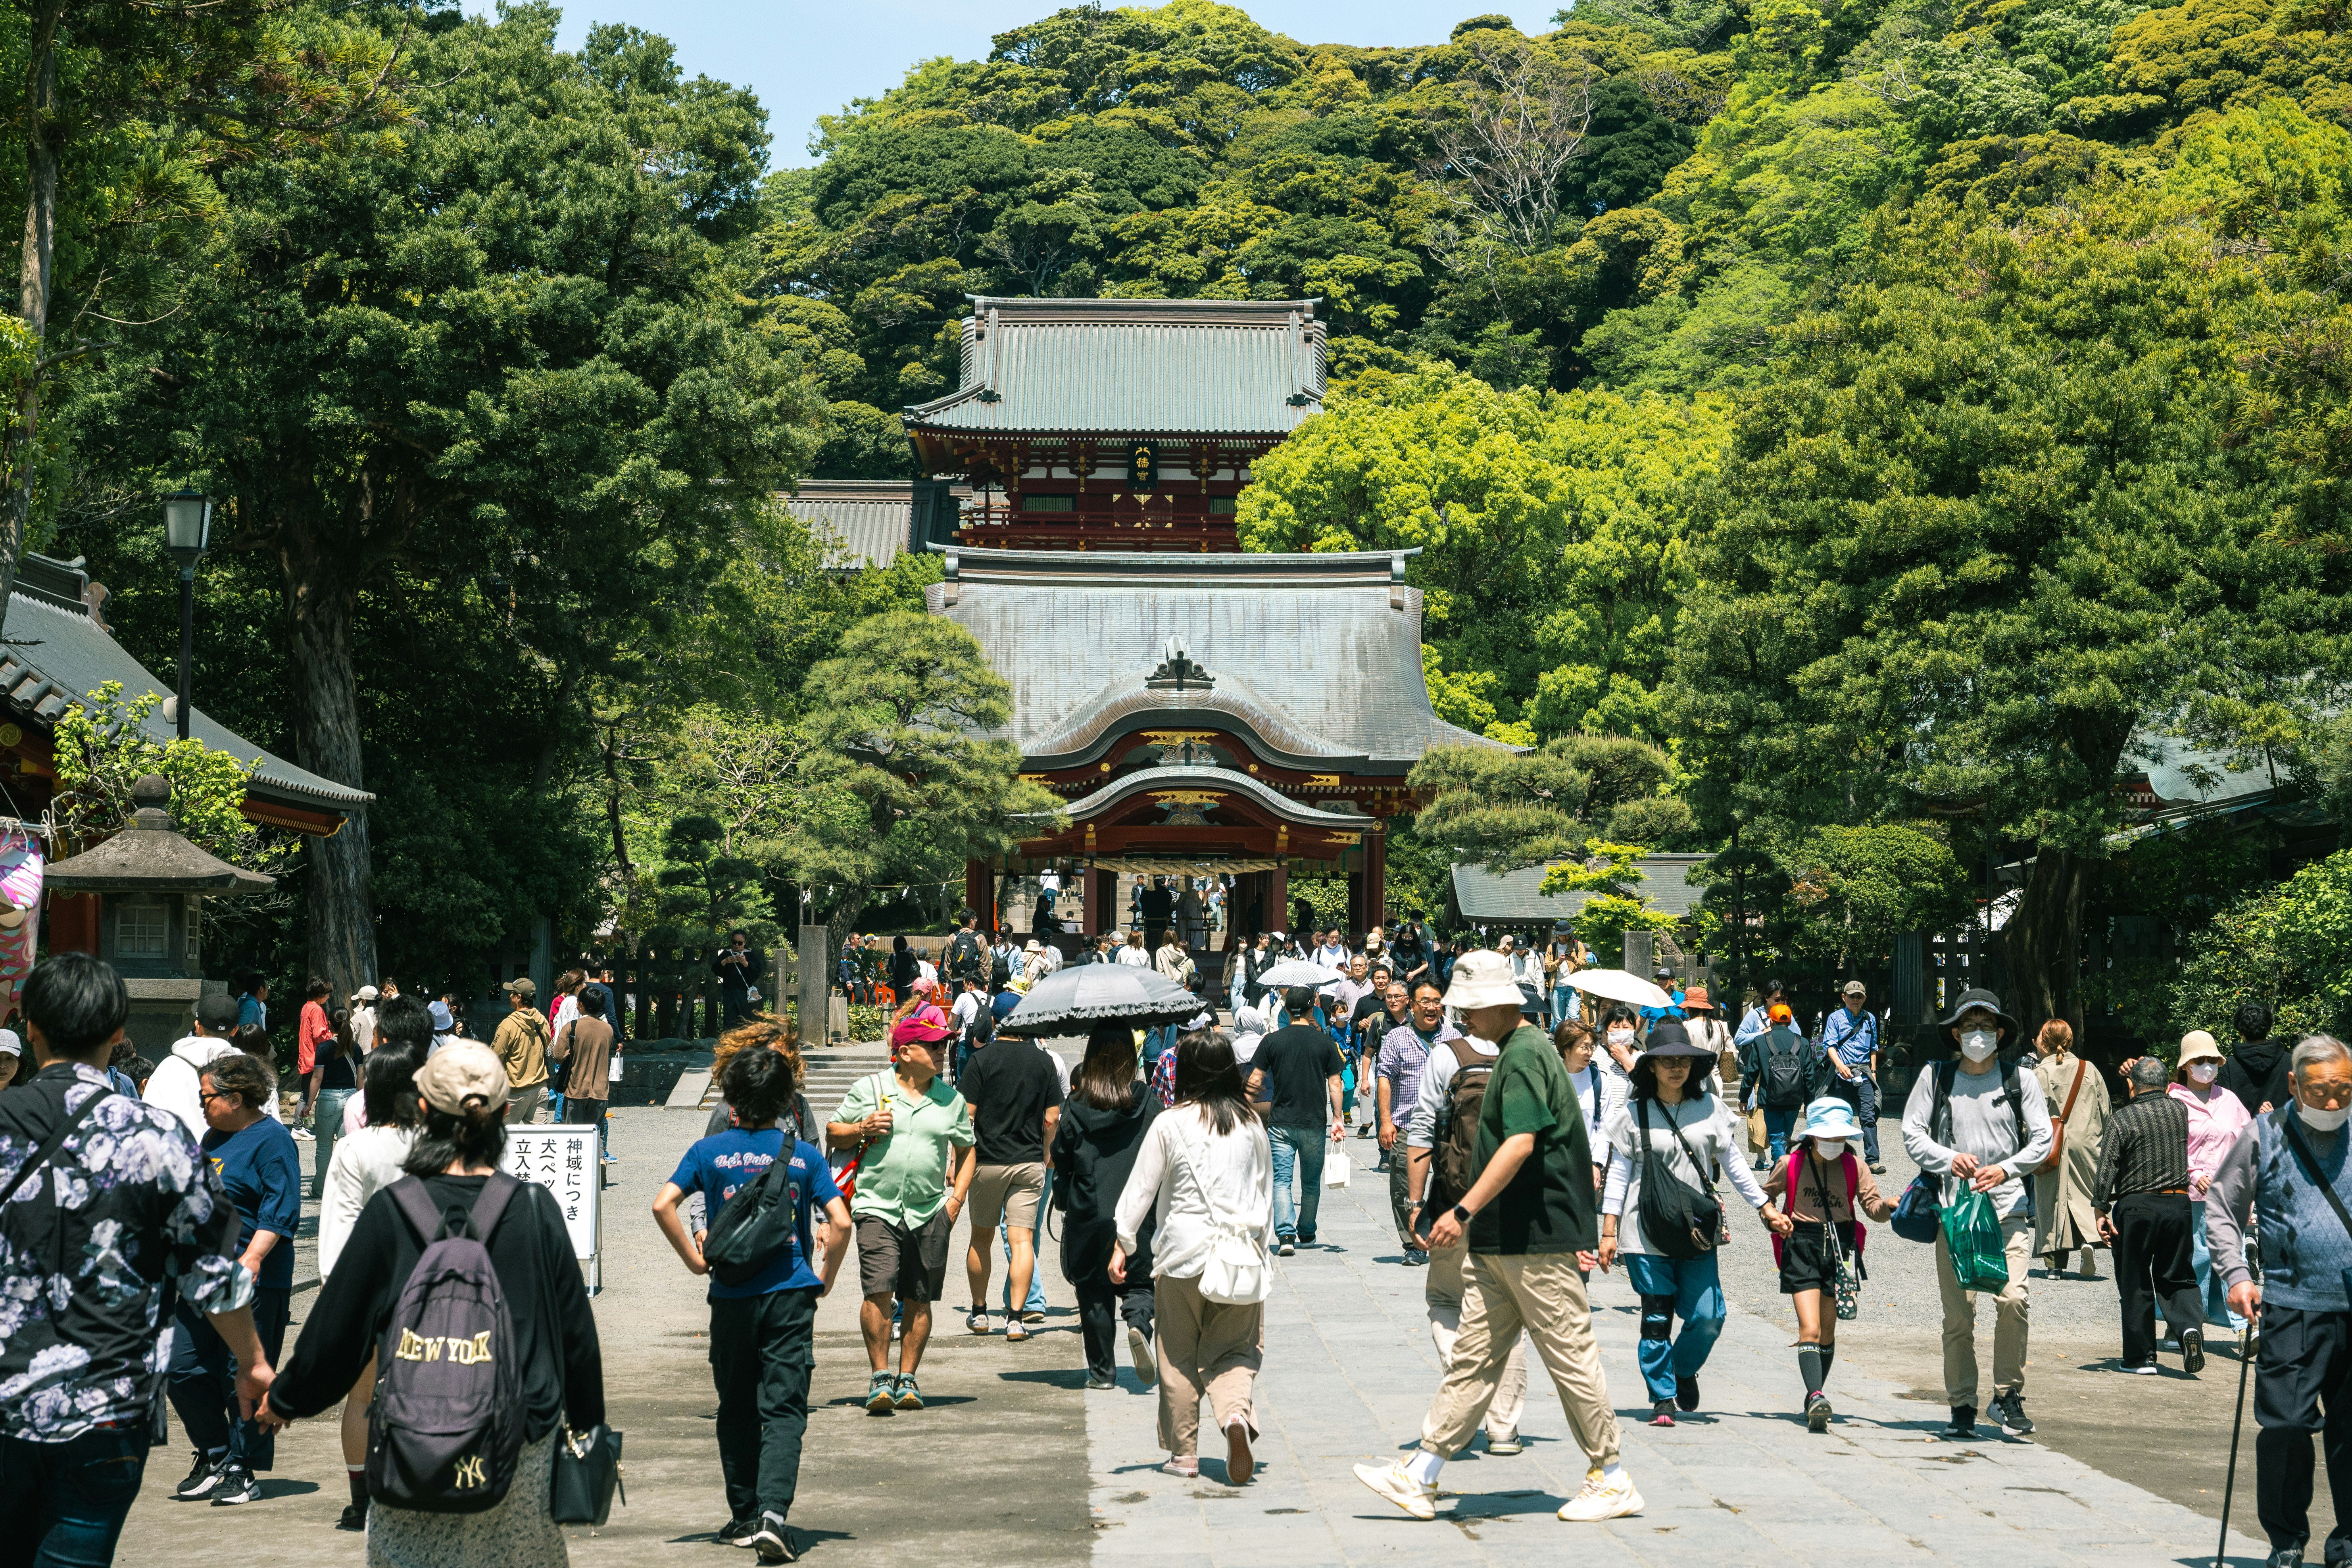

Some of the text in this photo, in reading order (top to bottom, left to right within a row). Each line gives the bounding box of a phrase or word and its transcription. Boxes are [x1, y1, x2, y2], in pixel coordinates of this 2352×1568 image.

[1135, 446, 1151, 481] 八幡宮
[713, 1152, 807, 1169] U.S. Polo sn.
[566, 1138, 582, 1220] 神域につき
[1803, 1187, 1832, 1197] Mae
[1813, 1197, 1843, 1208] Wsh
[395, 1327, 446, 1362] NEW
[453, 1454, 487, 1490] NY
